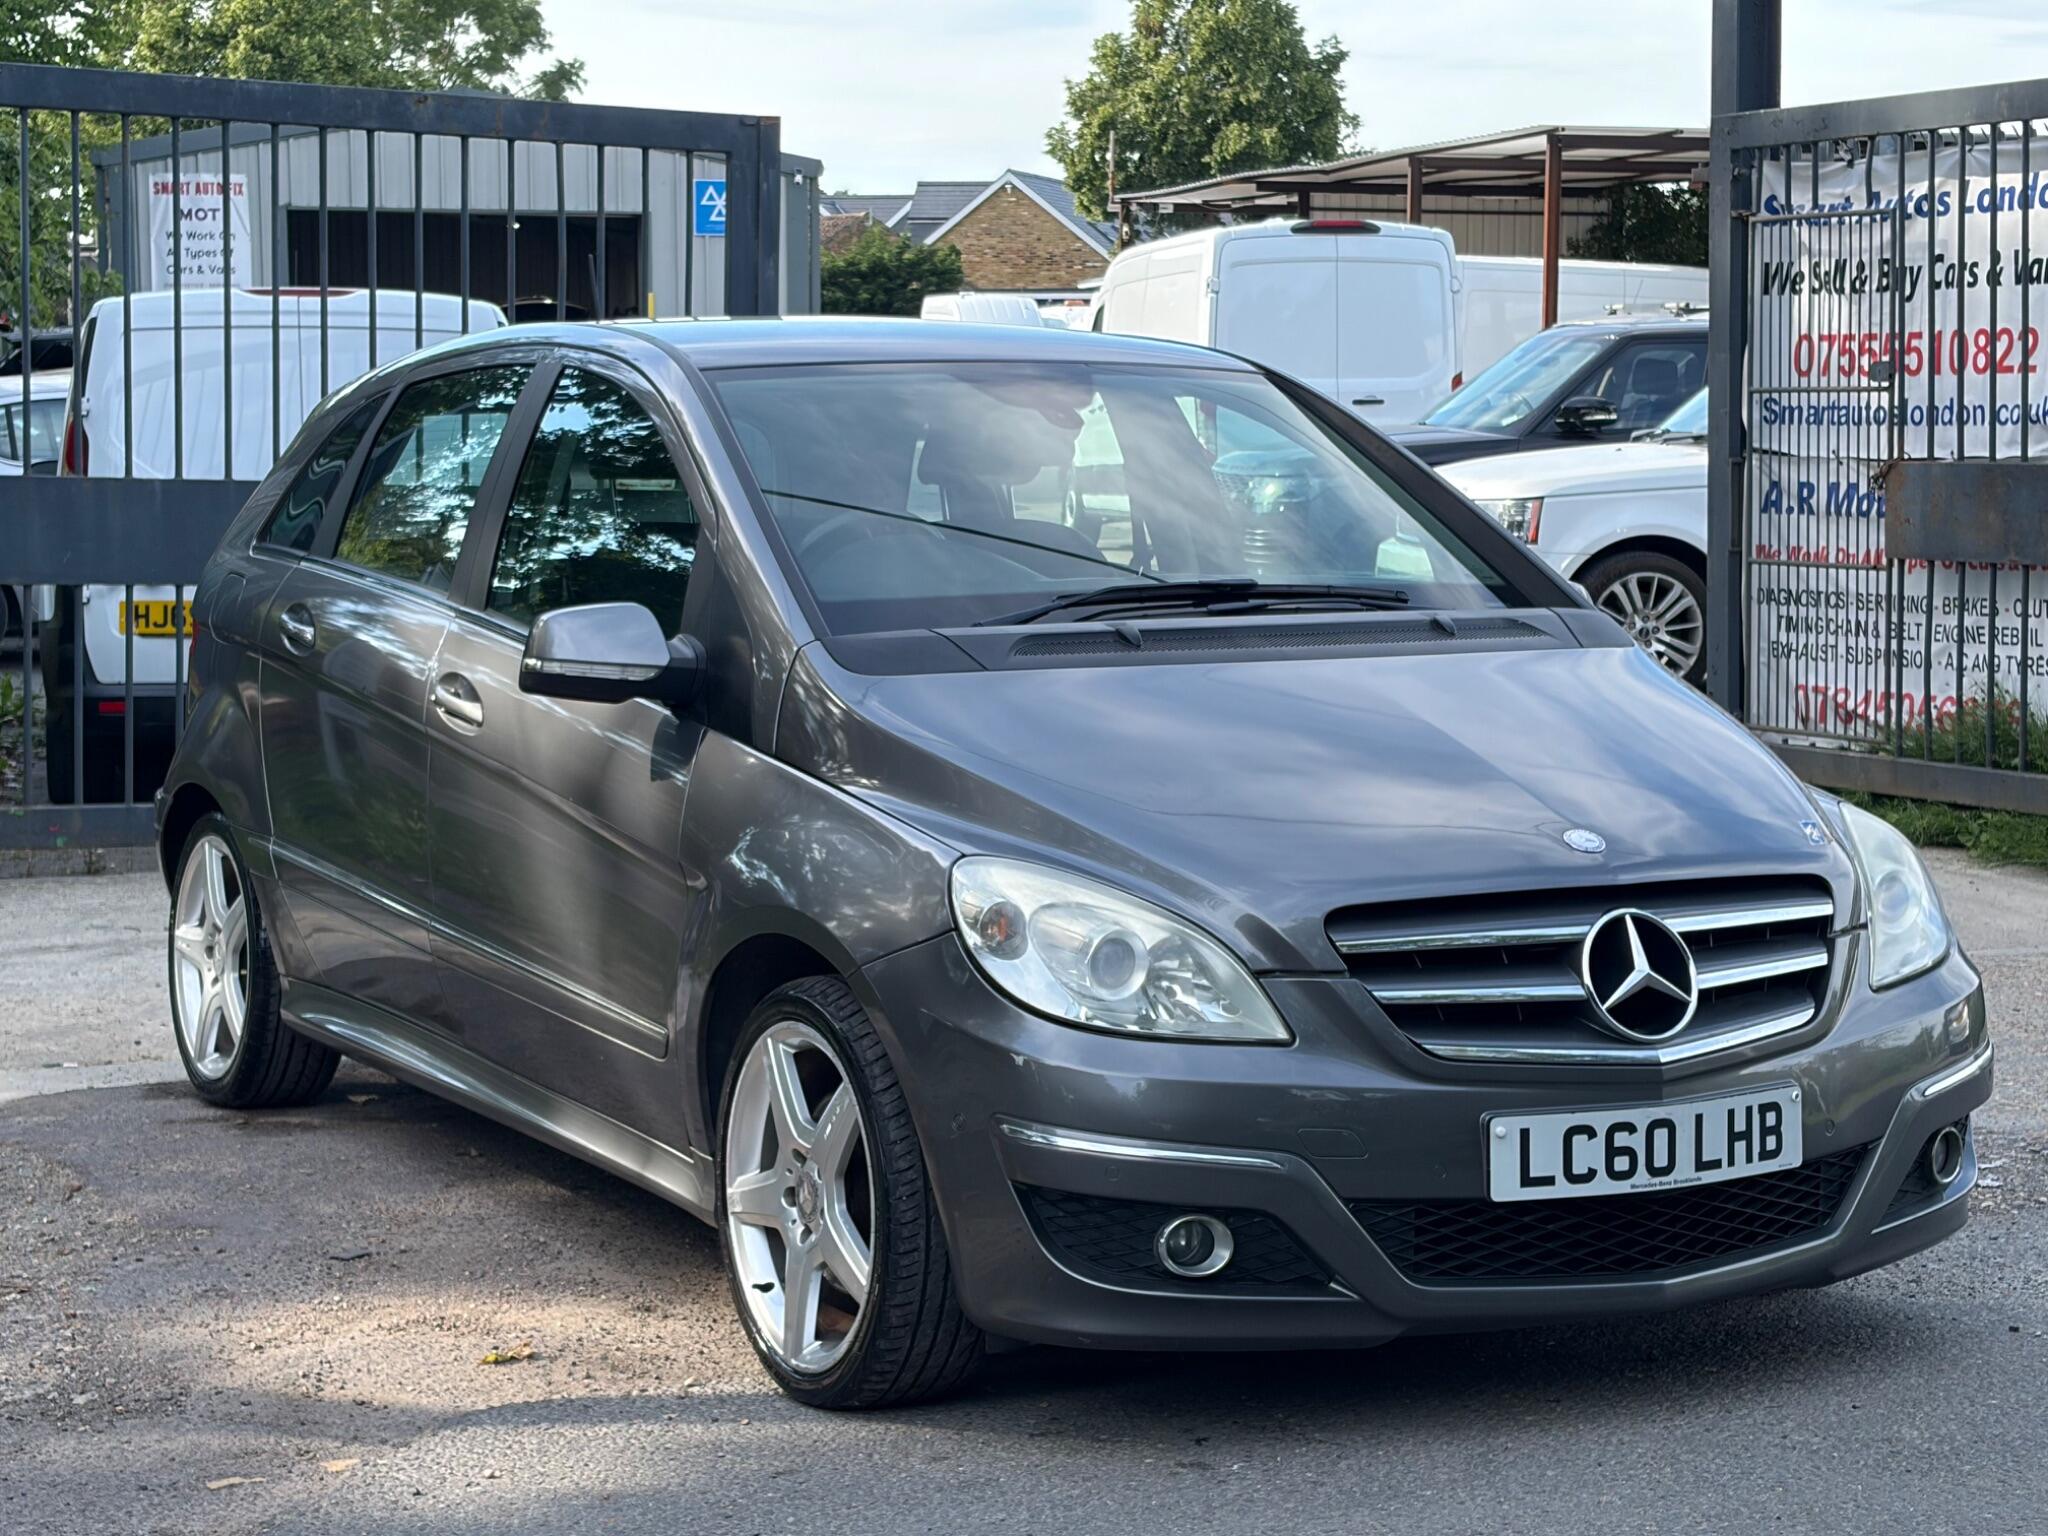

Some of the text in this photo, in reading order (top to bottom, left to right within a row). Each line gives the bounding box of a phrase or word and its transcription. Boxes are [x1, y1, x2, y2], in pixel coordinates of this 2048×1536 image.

[179, 208, 221, 221] MOT
[166, 231, 182, 241] W
[186, 231, 215, 241] Work
[184, 248, 217, 260] Types
[166, 265, 236, 275] Crs & Vas
[1762, 261, 1805, 296] We
[1811, 258, 1848, 295] Sell
[1851, 258, 1869, 295] &
[1763, 396, 2048, 427] Smartautoslondoncouk
[1857, 593, 1929, 614] SERIING
[1934, 624, 1986, 645] ENGNE
[1993, 626, 2044, 648] REBIL
[1846, 645, 1932, 671] SUSPNSIO
[1519, 1101, 1783, 1189] LC60 LHB
